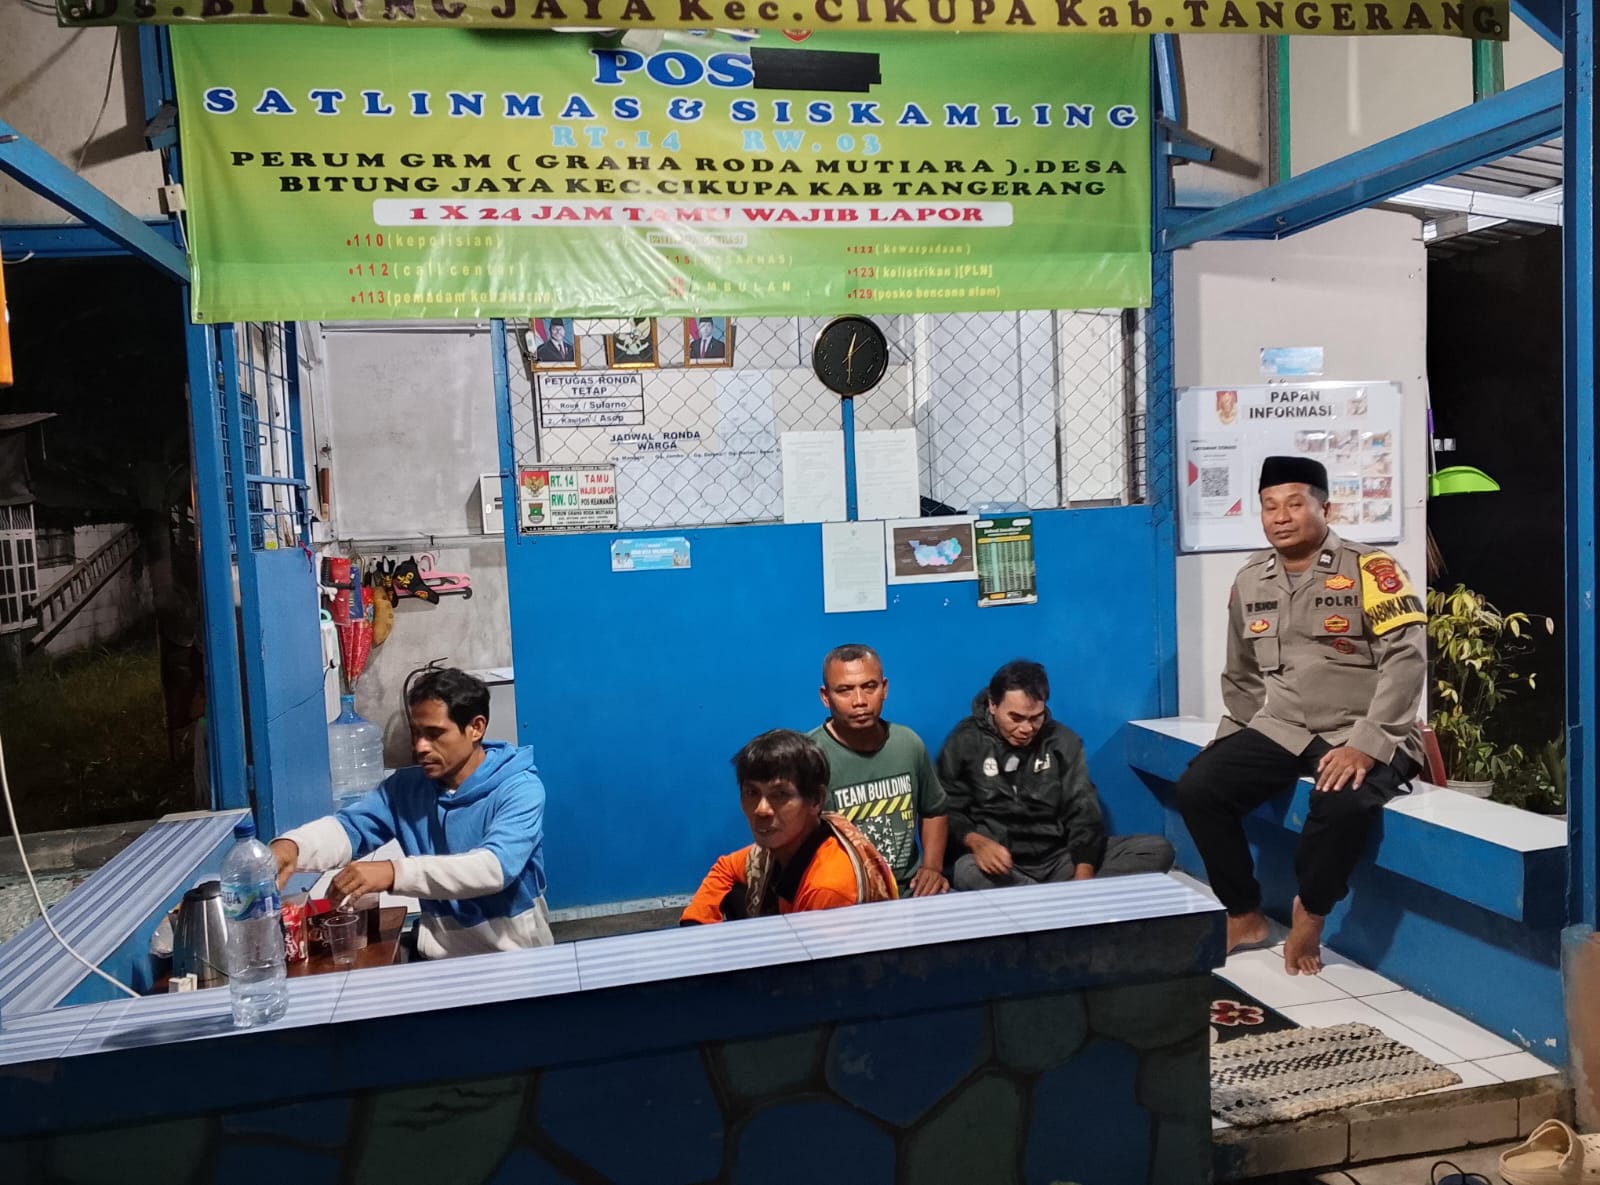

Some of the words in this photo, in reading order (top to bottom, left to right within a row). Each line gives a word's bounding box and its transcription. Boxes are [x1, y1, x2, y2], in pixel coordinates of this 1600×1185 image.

[591, 48, 753, 88] POS
[205, 88, 641, 121] SATLINMAS
[667, 98, 702, 121] &
[731, 100, 1139, 129] SISKAMLING
[231, 152, 386, 168] PERUM
[400, 154, 491, 170] GRM
[535, 155, 682, 172] GRAHA
[695, 158, 802, 173] RODA
[816, 159, 993, 175] MUTIARA
[279, 176, 440, 193] BITUNG
[454, 178, 552, 194] JAYA
[809, 181, 884, 196] KAB
[893, 181, 1106, 197] TANGERANG
[410, 208, 427, 221] 1
[441, 207, 470, 221] X
[479, 208, 521, 222] 24
[531, 208, 614, 222] JAM
[622, 208, 732, 223] TAMU
[741, 209, 860, 223] WAJIB
[868, 209, 984, 223] LAPOR
[545, 376, 594, 387] PETUGAS
[598, 375, 637, 386] RONDA
[572, 387, 607, 397] TETAP
[1271, 390, 1320, 403] PAPAN
[1250, 404, 1333, 419] INFORMASI
[610, 431, 655, 443] JADWAL
[663, 430, 701, 440] RONDA
[637, 441, 677, 451] WARGA
[550, 475, 562, 487] RT.
[565, 475, 574, 487] 14
[585, 474, 609, 484] TAMU
[552, 494, 566, 506] RW.
[568, 494, 577, 506] 03
[1315, 595, 1359, 608] POLRI
[835, 783, 868, 809] TEAM
[868, 775, 912, 802] BUILDING
